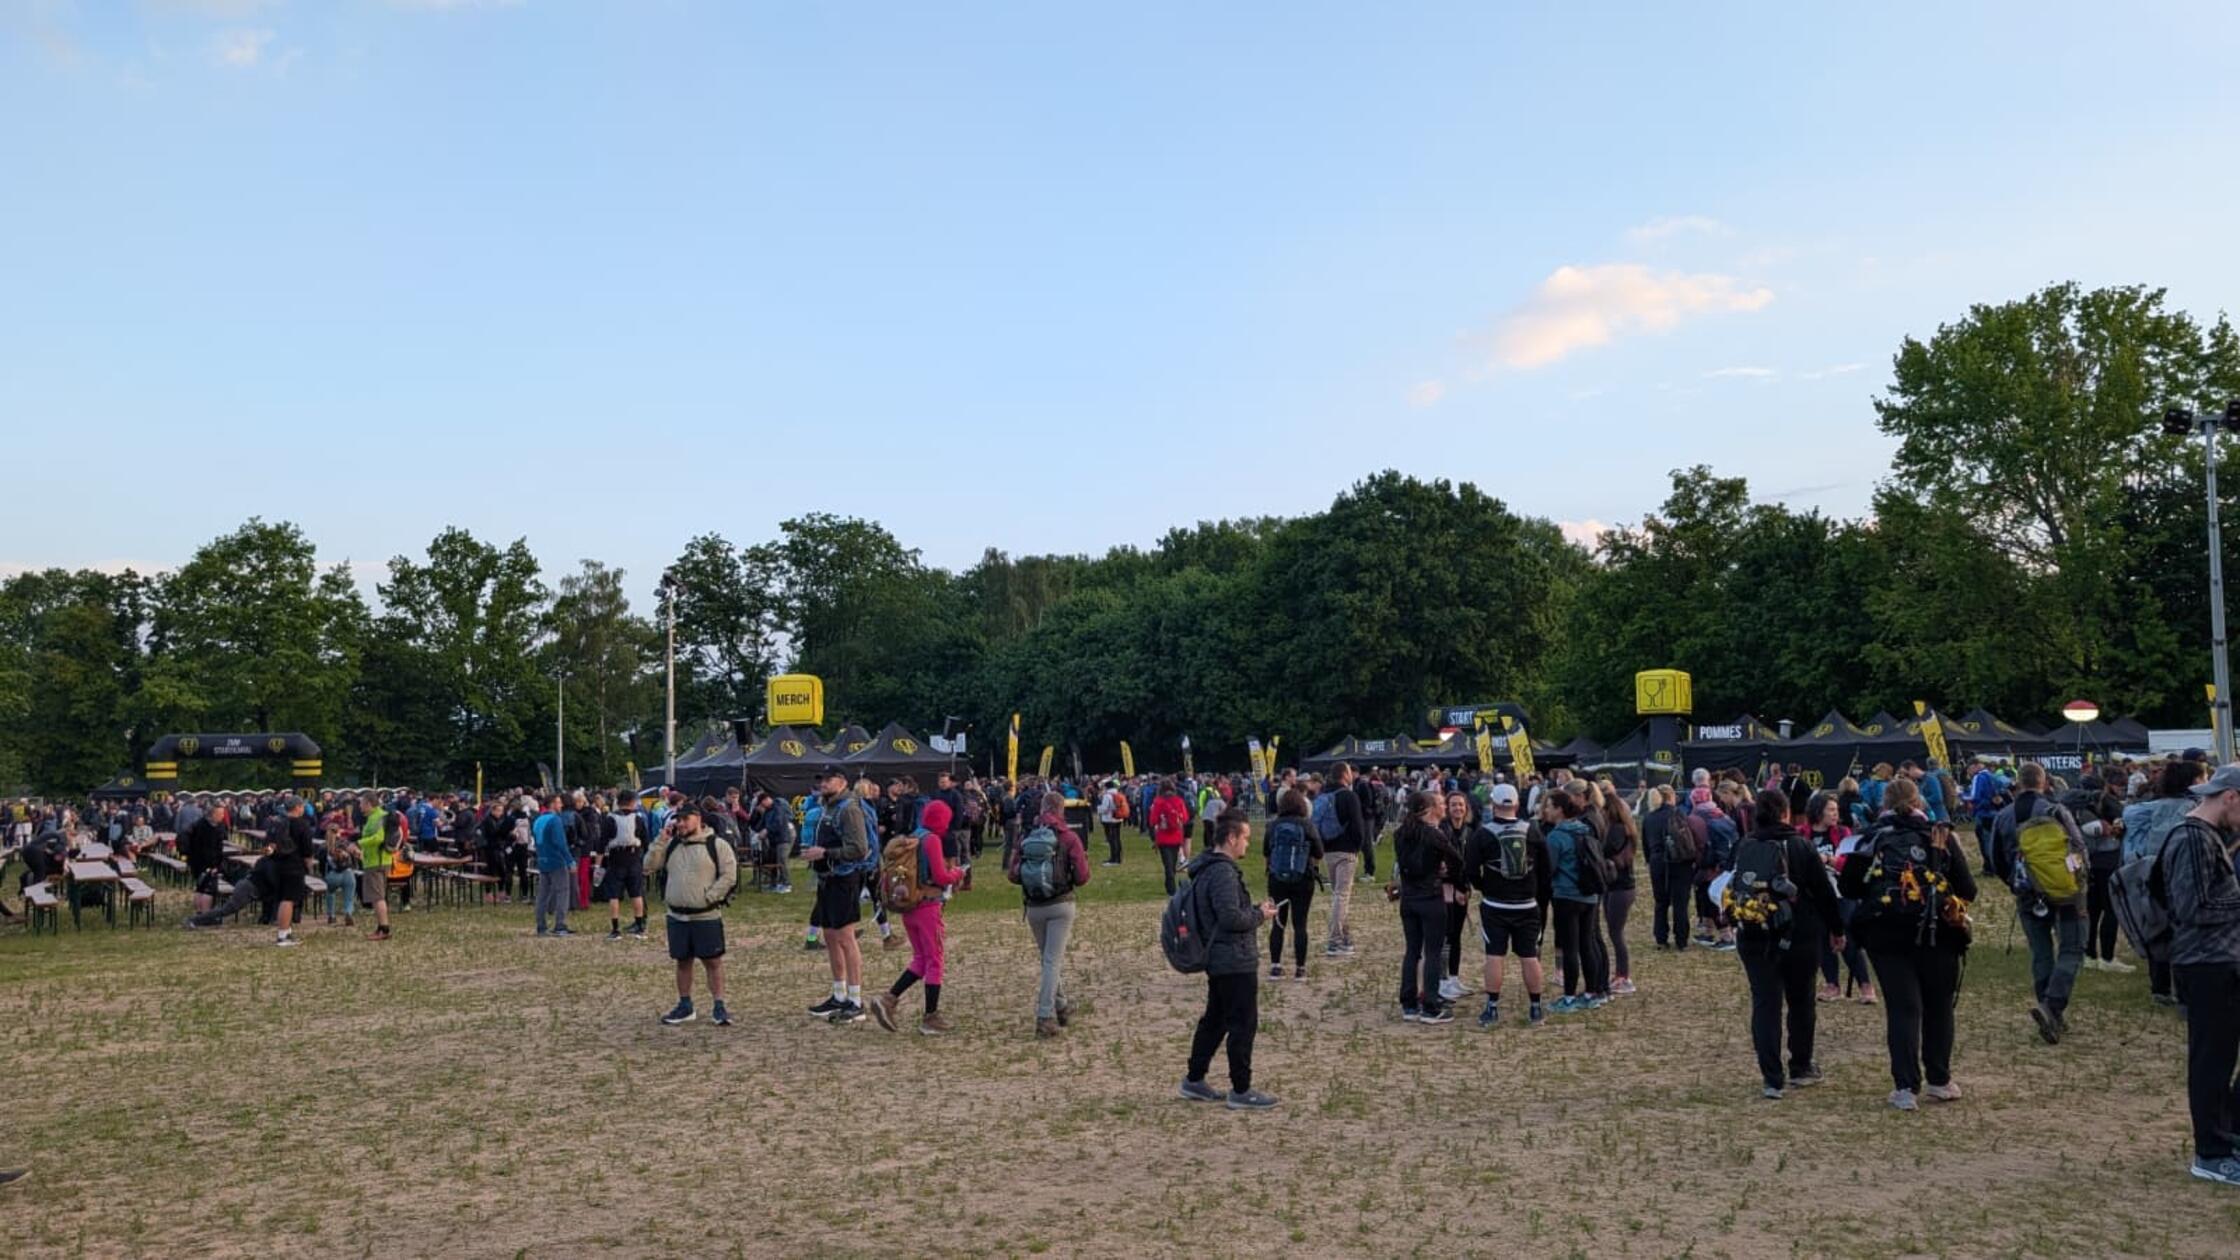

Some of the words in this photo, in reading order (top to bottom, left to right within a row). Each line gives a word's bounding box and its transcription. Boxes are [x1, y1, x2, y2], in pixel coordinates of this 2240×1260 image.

[776, 693, 810, 706] MERCH
[1449, 710, 1475, 726] START
[1700, 725, 1742, 740] POMMES
